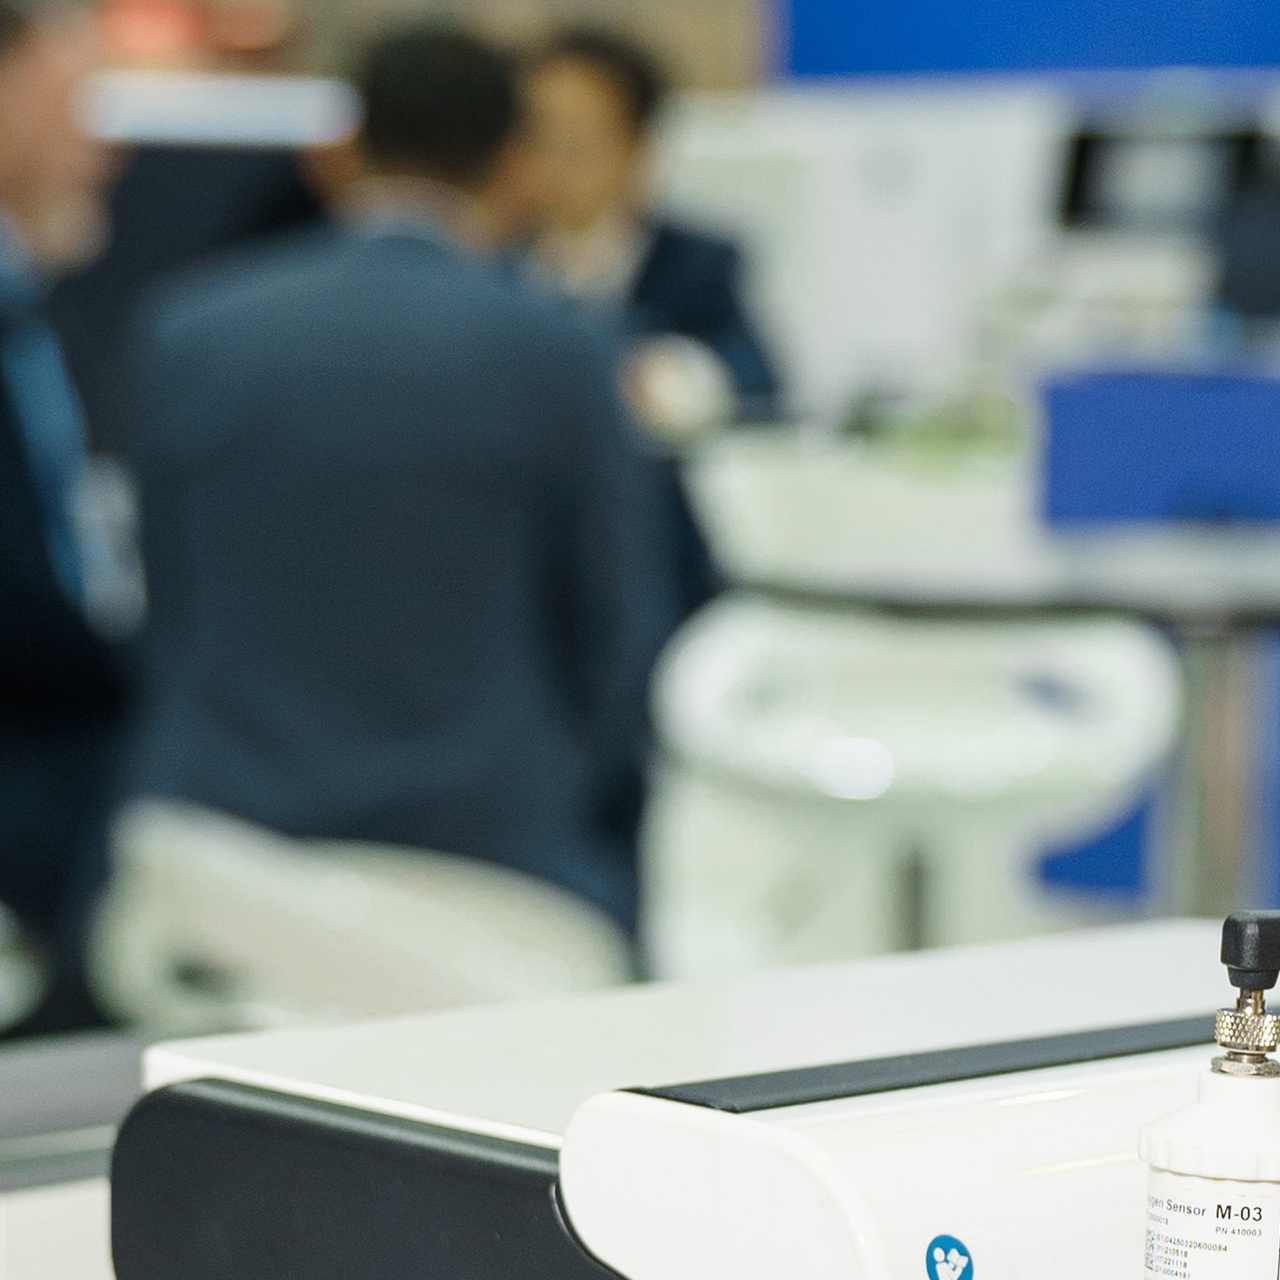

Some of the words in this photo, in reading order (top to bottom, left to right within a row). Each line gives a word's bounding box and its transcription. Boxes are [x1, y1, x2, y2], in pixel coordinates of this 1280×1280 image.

[1166, 1198, 1207, 1217] Sensor
[1215, 1203, 1263, 1222] M-03
[1230, 1228, 1263, 1238] 410003
